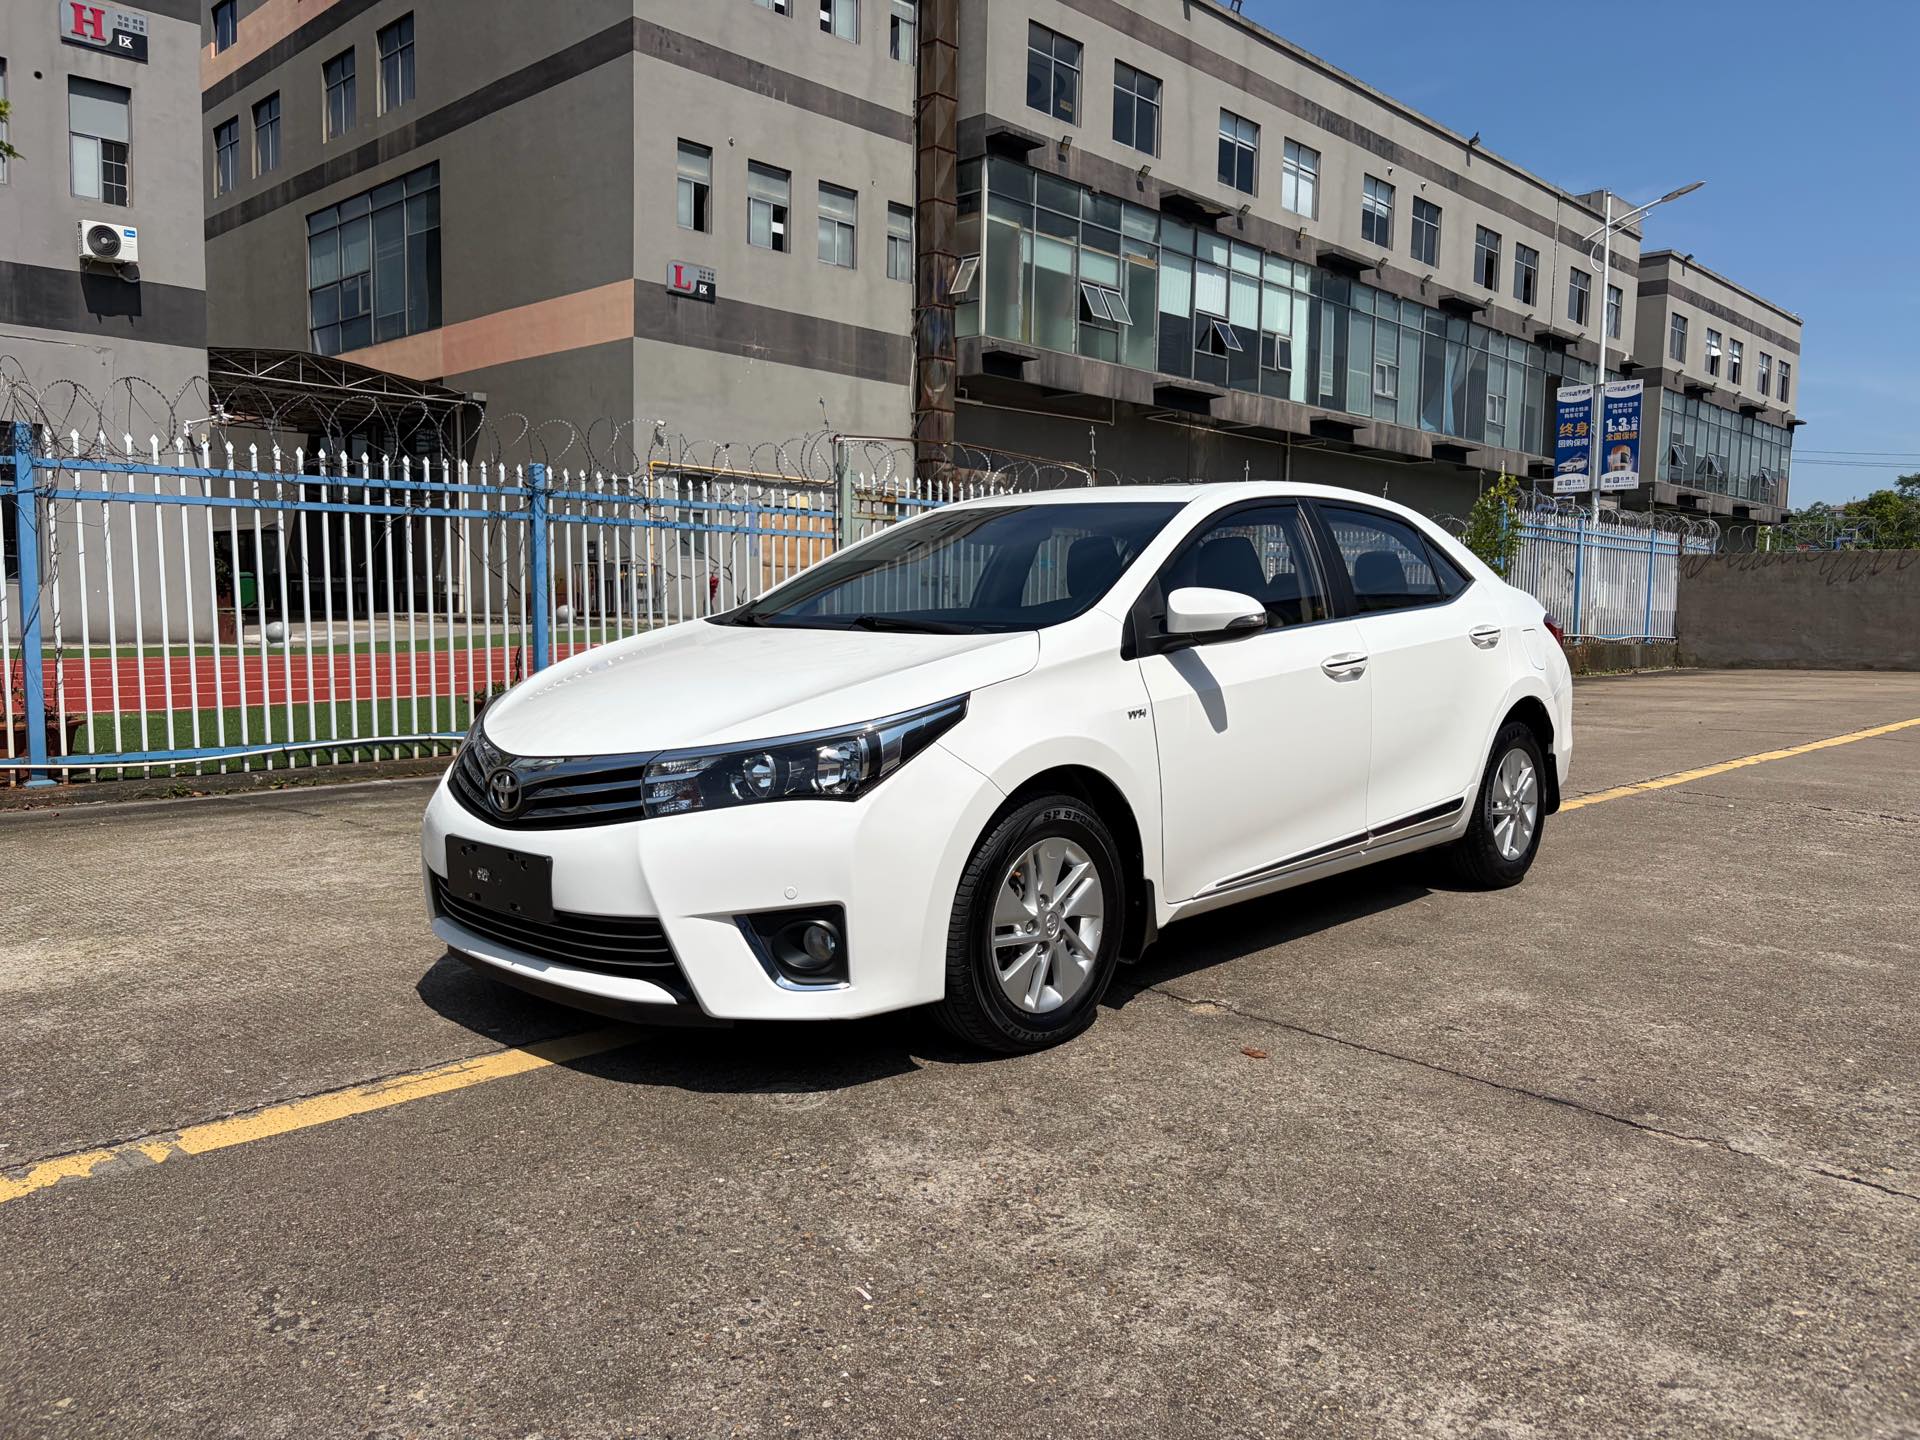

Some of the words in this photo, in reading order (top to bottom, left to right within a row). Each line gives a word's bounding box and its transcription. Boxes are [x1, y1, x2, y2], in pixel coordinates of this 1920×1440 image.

[71, 2, 106, 41] H
[119, 35, 133, 49] 区
[674, 264, 692, 290] L
[699, 284, 708, 294] 区
[1560, 421, 1589, 436] 终身
[1043, 810, 1060, 821] SP
